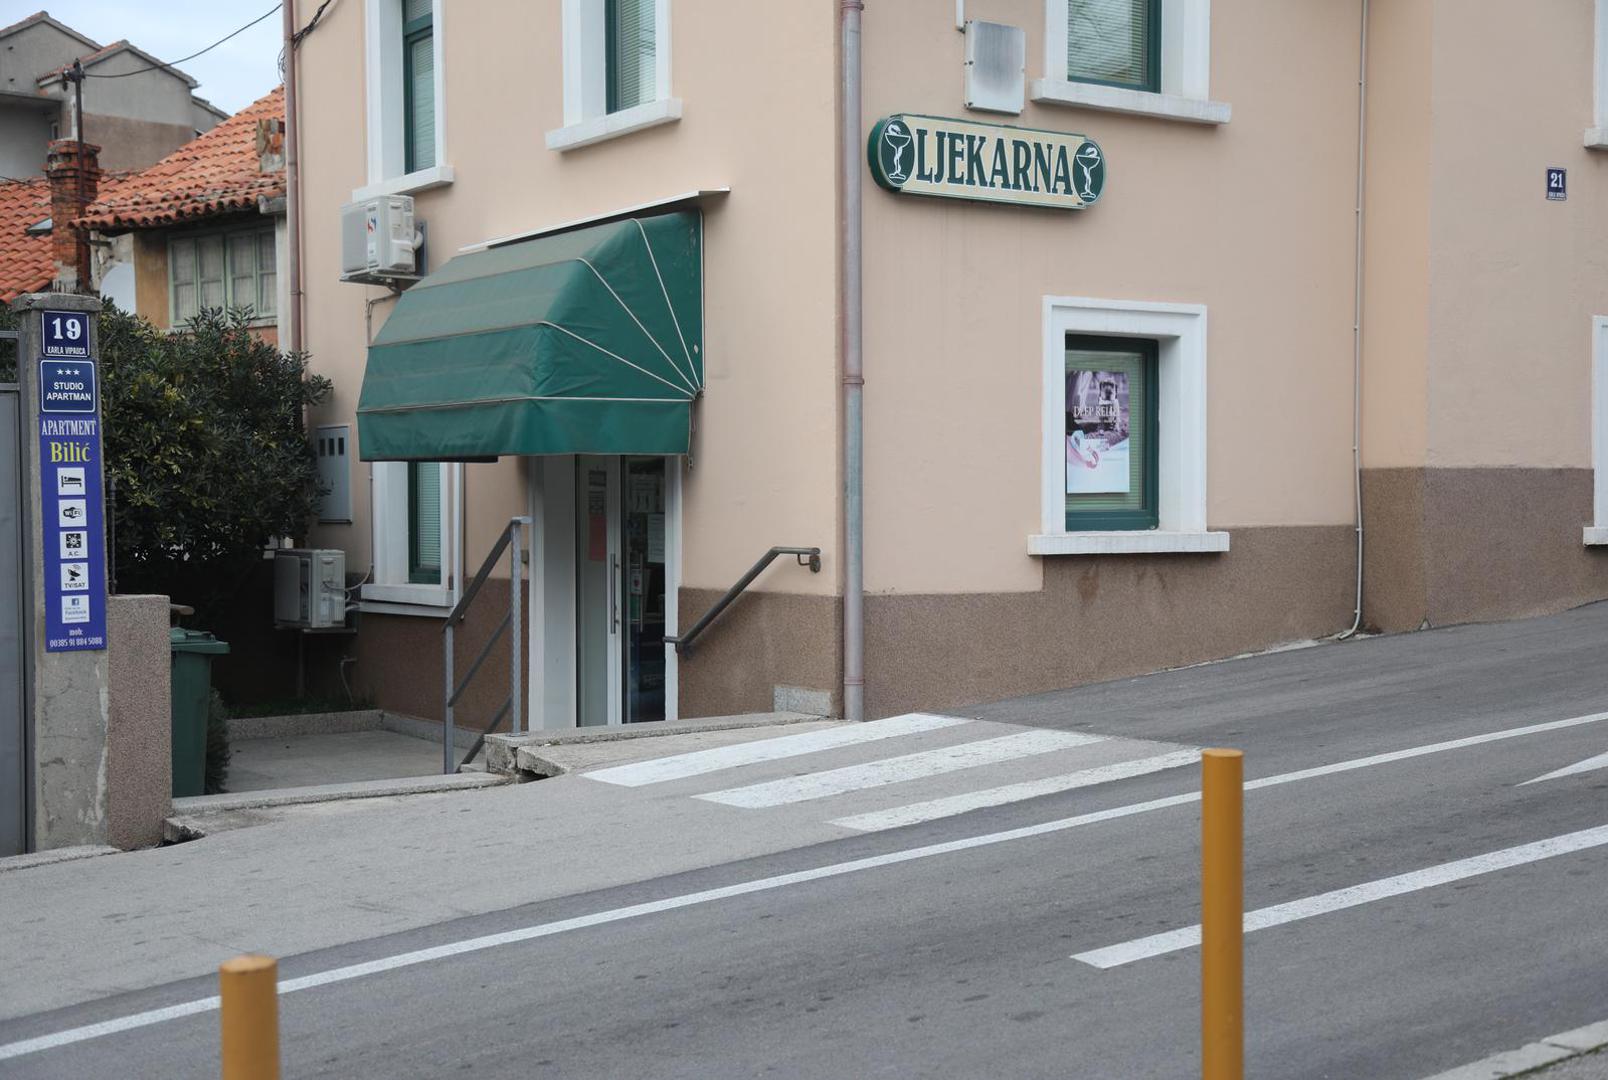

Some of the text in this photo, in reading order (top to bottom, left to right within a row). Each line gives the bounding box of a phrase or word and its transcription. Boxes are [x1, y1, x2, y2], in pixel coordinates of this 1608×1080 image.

[915, 128, 1073, 196] LJEKARNA
[1550, 172, 1563, 188] 21
[52, 318, 81, 340] 19
[47, 346, 64, 354] KARLA
[53, 381, 84, 391] STUDIO
[46, 392, 91, 401] APARTMAN
[42, 418, 96, 436] APARTMENT
[50, 441, 91, 462] Bilić
[50, 639, 68, 647] 00385
